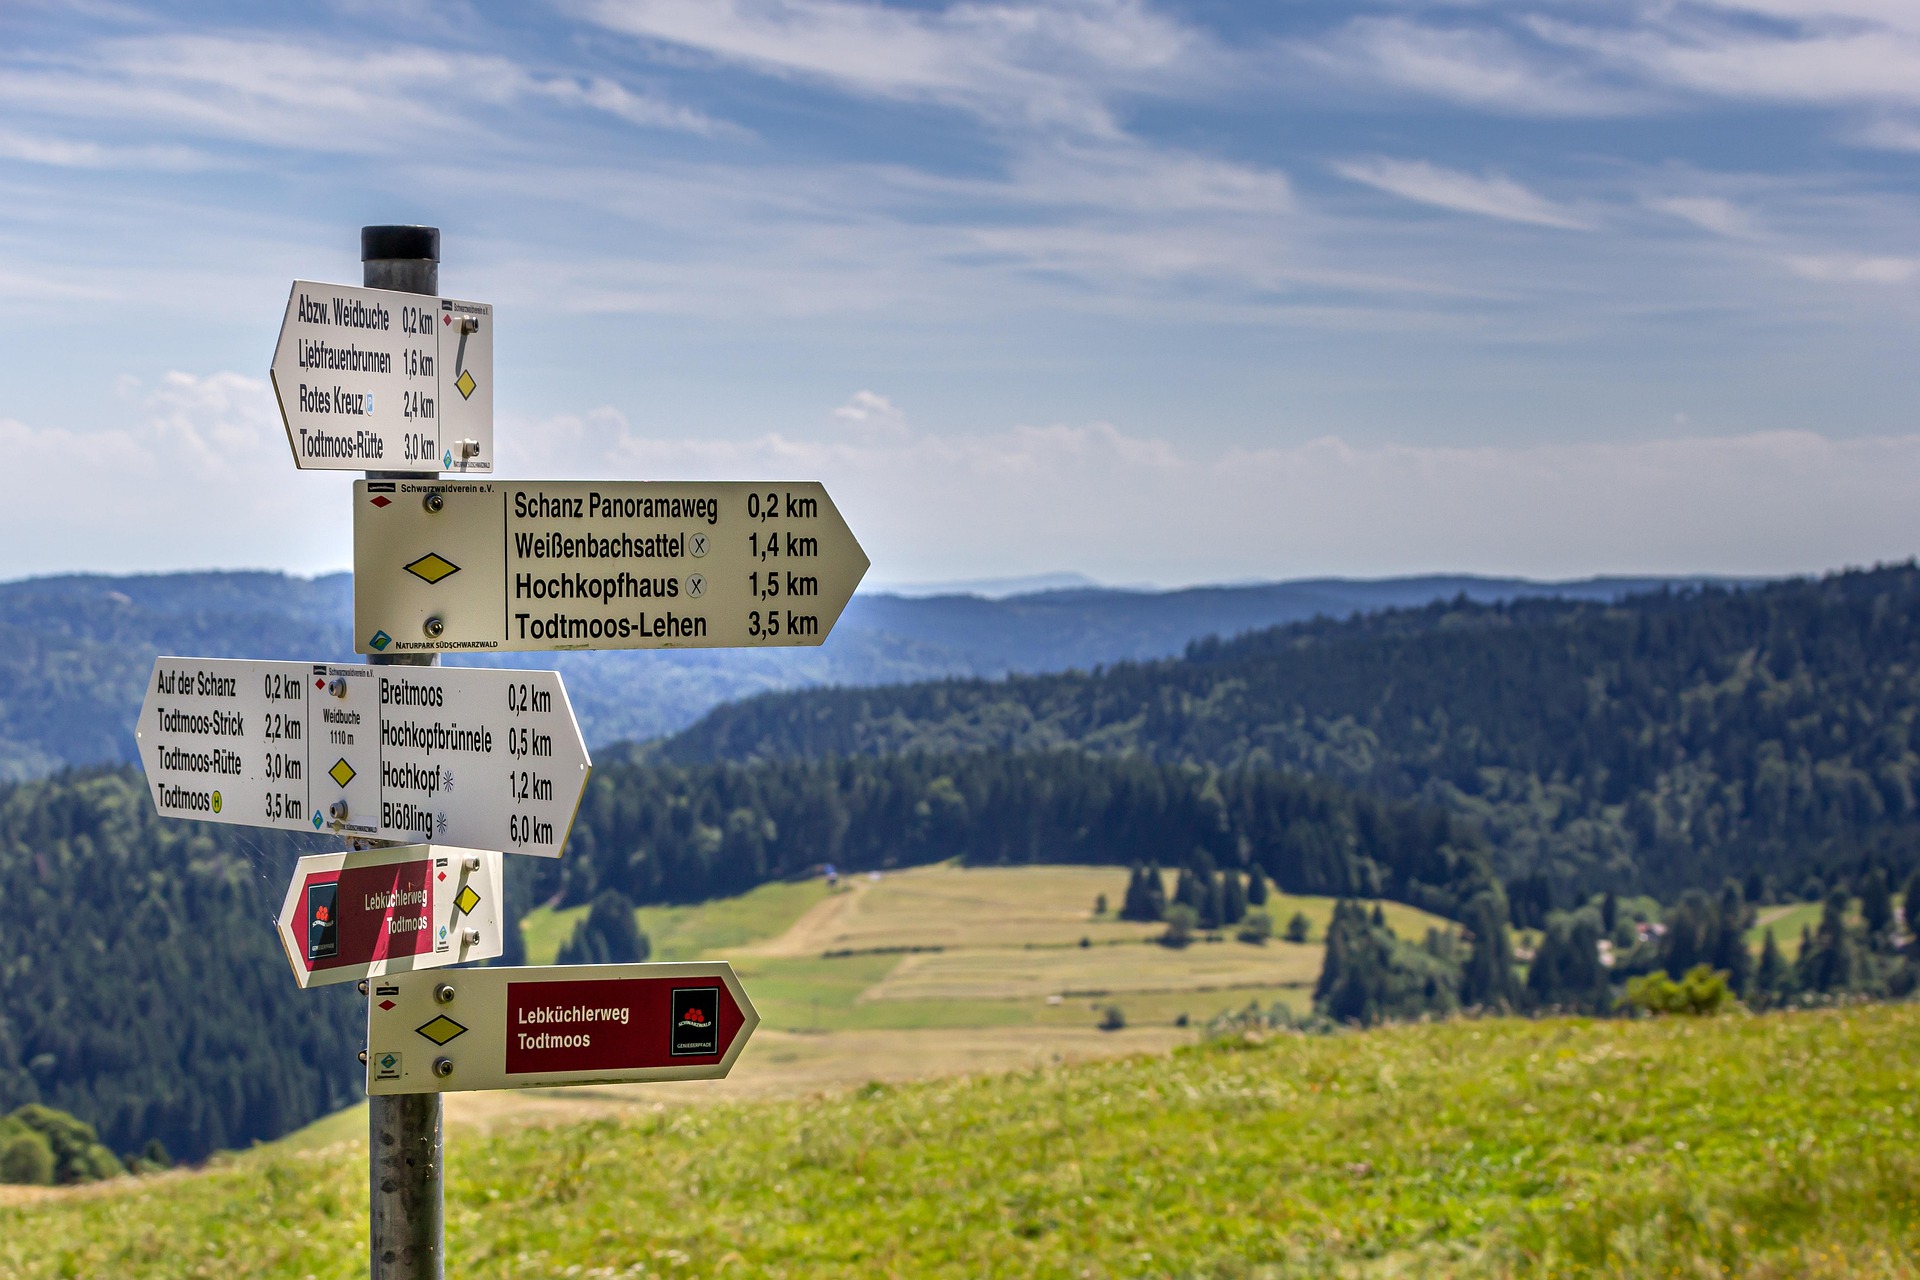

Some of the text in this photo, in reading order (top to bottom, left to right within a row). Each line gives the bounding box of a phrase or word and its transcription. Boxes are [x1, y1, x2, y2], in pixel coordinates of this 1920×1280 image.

[298, 294, 433, 338] Abzw. Weidbuche 0,2 km
[299, 338, 434, 380] Liebfrauenbrunnen 1,6 km
[300, 384, 330, 414] Rotes
[334, 386, 363, 416] Kreuz
[404, 391, 418, 422] 2,4
[420, 392, 434, 418] km
[300, 429, 434, 464] Todtmoos-Rütte 3,0 km
[401, 484, 477, 493] Schwarzwaldverein
[480, 484, 494, 493] e.V.
[514, 492, 818, 525] Schanz Panoramaweg 0,2 km
[515, 532, 818, 561] Weißenbachsattel 1,4 km
[516, 571, 818, 604] Hochkopfhaus 1,5 km
[515, 610, 818, 640] Todtmoos-Lehen 3,5 km
[396, 641, 498, 649] NATURPARK SÜDSCHWARZWALD
[157, 670, 301, 703] Auf der Schanz 0,2 km
[382, 678, 551, 716] Breitmoos 0,2 km
[158, 708, 301, 743] Todtmoos-Strick 2,2 km
[323, 708, 360, 725] Weidbuche
[330, 730, 354, 745] 1110 m
[382, 719, 552, 760] Hochkopfbrünnele 0,5 km
[158, 746, 301, 782] Todtmoos-Rütte 3,0 km
[382, 761, 552, 804] Hochkopf 1,2 km
[158, 783, 210, 811] Todtmoos
[266, 793, 282, 822] 3,5
[285, 794, 301, 819] km
[383, 802, 553, 847] Blößling 6,0 km
[365, 889, 427, 911] Lebküchlerweg
[387, 916, 427, 935] Todtmoos
[518, 1006, 629, 1025] Lebküchlerweg
[518, 1032, 590, 1050] Todtmoos
